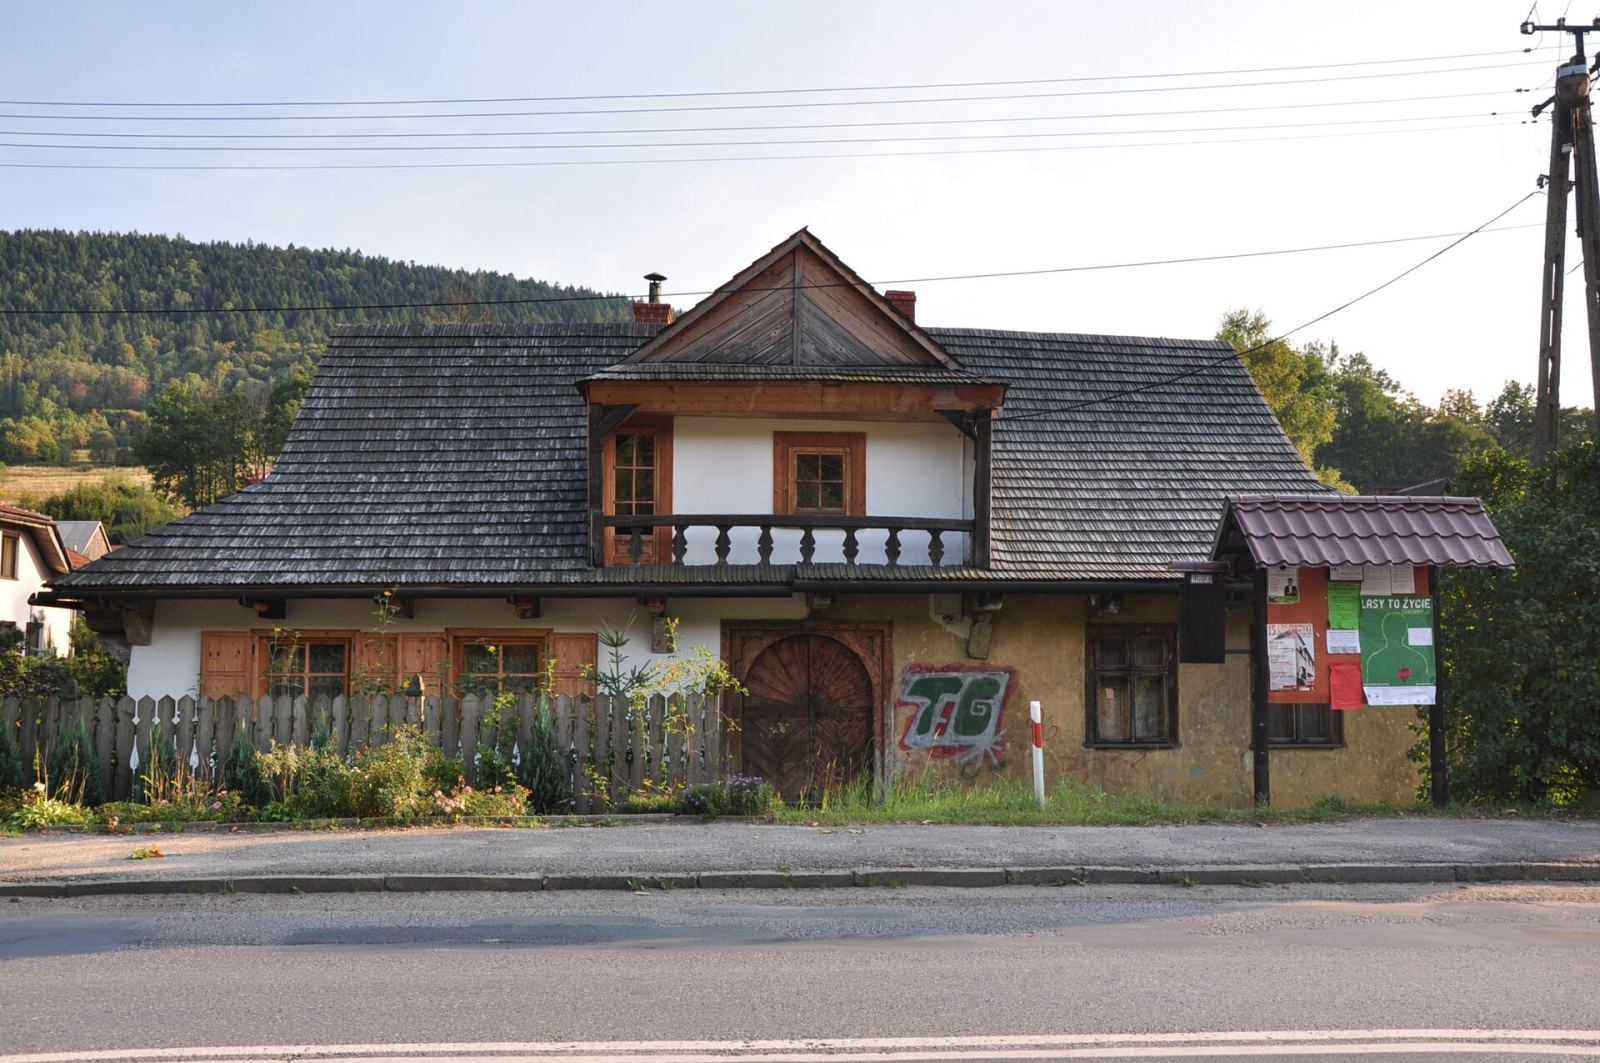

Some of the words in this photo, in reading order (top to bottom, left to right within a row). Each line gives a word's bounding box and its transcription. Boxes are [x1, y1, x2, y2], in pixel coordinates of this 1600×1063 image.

[1361, 599, 1385, 609] LASY
[1387, 599, 1400, 609] TO
[1402, 597, 1432, 609] ŻYCIE
